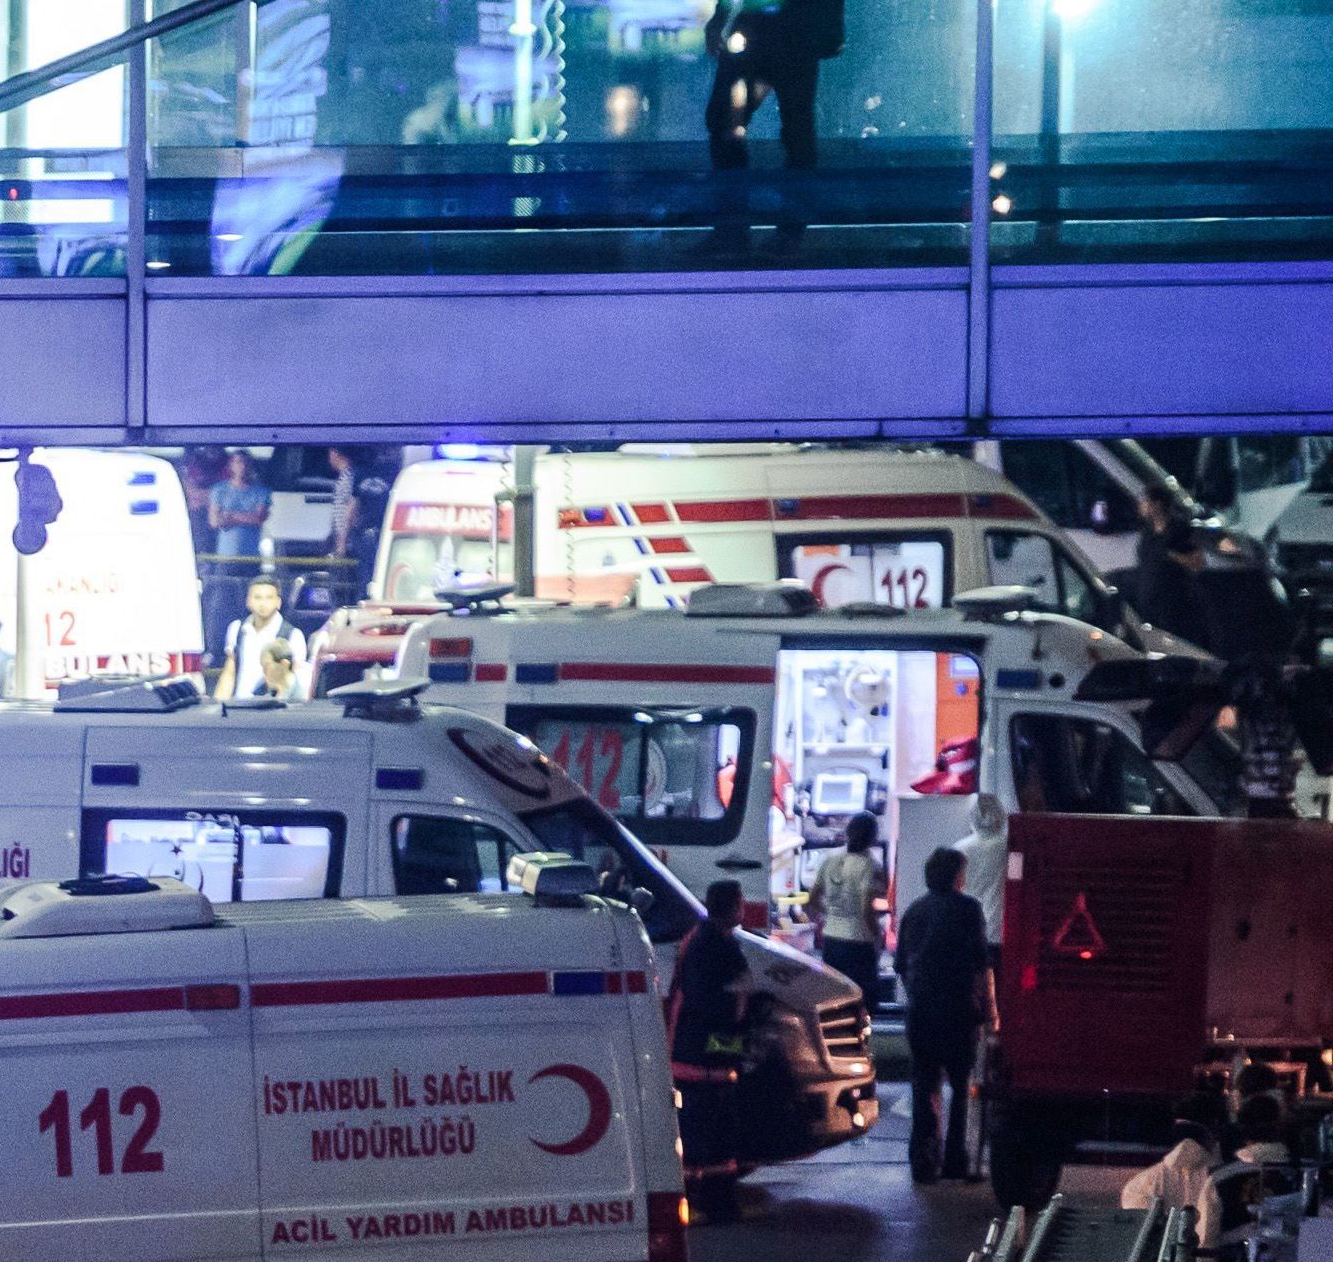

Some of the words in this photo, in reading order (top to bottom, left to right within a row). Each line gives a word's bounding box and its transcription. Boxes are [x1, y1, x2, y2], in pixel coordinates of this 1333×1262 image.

[881, 568, 929, 609] 112
[44, 611, 77, 646] 12
[44, 652, 172, 680] BULANS
[263, 1074, 387, 1116] İSTANBUL
[393, 1068, 416, 1108] İL
[422, 1065, 517, 1107] SAĞLIK
[38, 1085, 165, 1178] 112
[310, 1115, 477, 1163] MÜDÜRLÜĞÜ
[271, 1214, 337, 1245] ACİL
[345, 1210, 456, 1240] YARDIM
[464, 1199, 636, 1234] AMBULANSI
